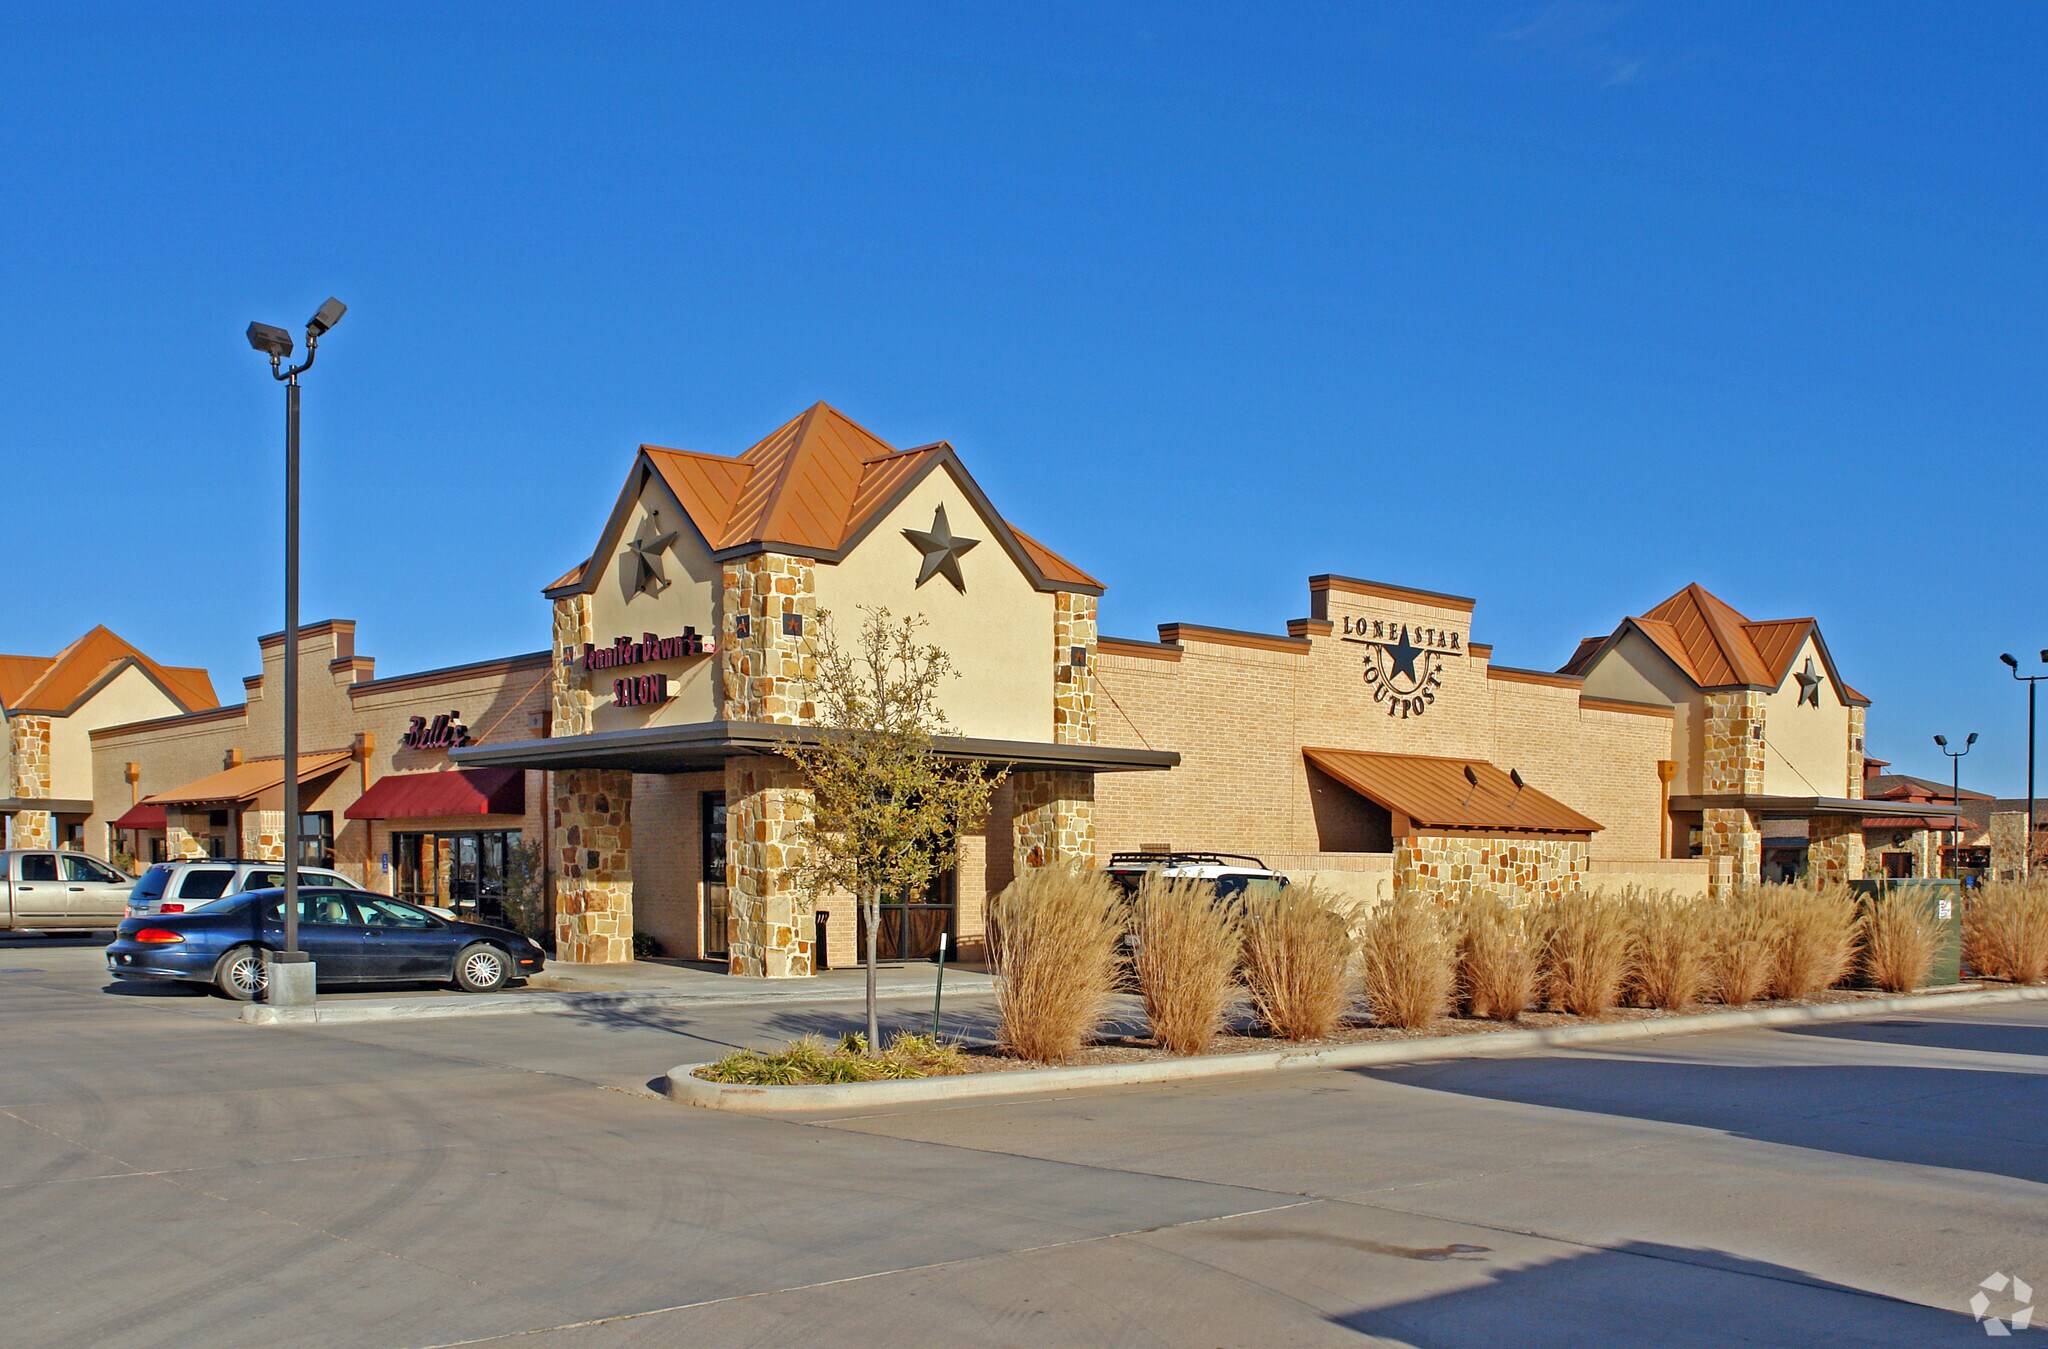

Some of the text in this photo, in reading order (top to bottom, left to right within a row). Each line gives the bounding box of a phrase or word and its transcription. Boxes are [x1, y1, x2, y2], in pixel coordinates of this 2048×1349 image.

[582, 626, 702, 670] Jennifer Dawn's
[1343, 616, 1460, 650] LONE STAR
[614, 674, 667, 707] SALON
[1363, 666, 1442, 719] OUTPOST
